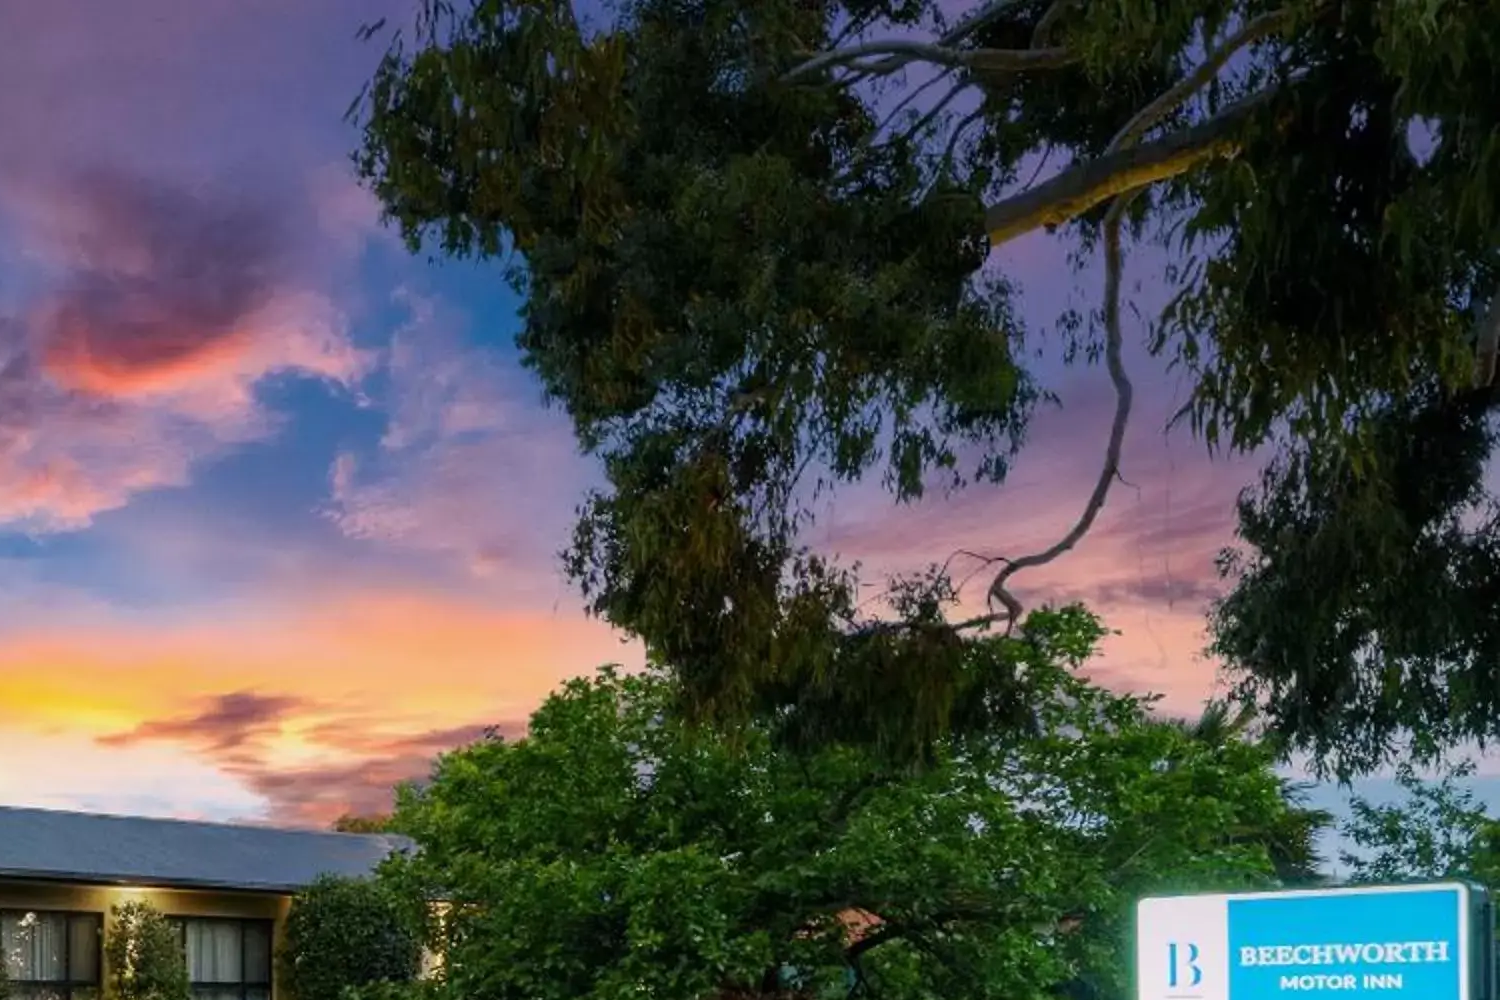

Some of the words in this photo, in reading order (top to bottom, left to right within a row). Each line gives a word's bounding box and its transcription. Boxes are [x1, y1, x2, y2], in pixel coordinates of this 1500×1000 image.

[1168, 943, 1202, 987] B
[1239, 941, 1449, 967] BEECHWORTH
[1280, 974, 1356, 991] MOTOR
[1363, 974, 1403, 989] INN
